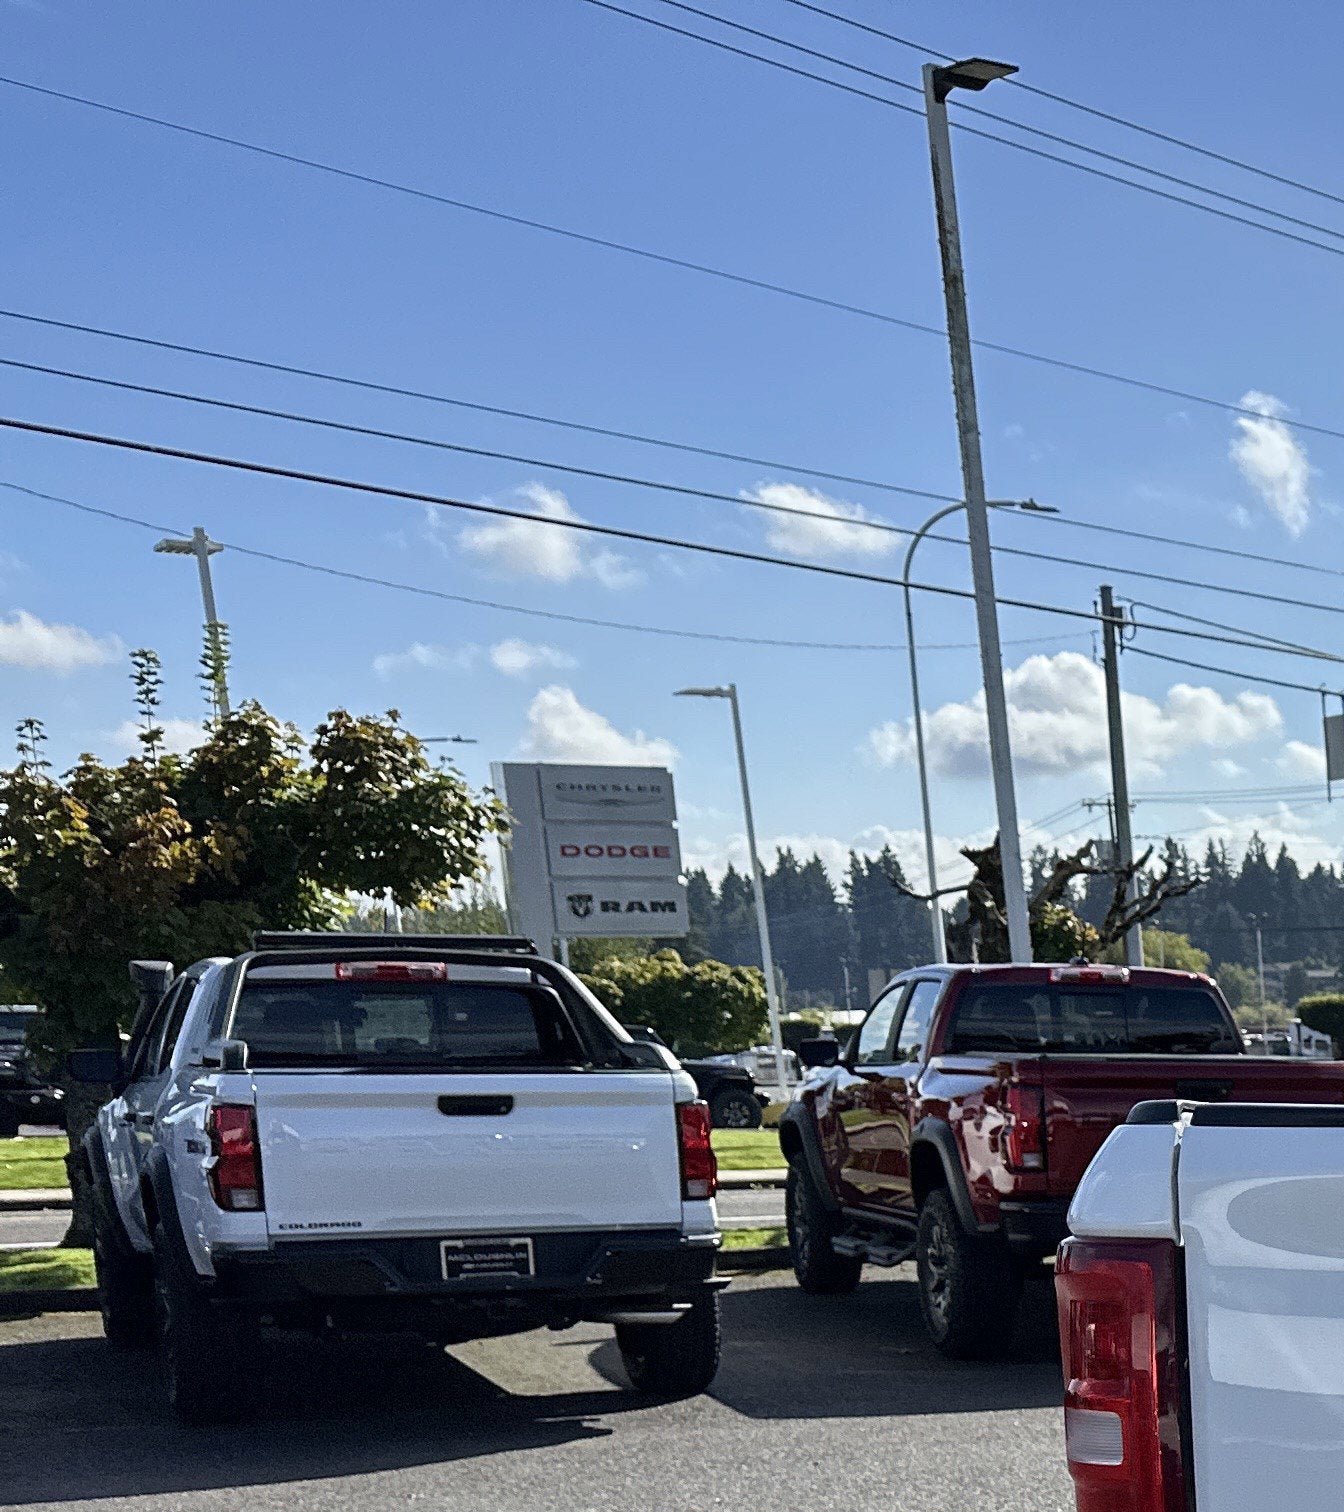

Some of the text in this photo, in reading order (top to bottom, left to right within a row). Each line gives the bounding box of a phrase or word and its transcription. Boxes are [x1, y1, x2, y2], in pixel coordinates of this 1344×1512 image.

[555, 782, 662, 794] CHRYSLER
[560, 845, 673, 858] DODGE
[601, 901, 677, 913] RAM
